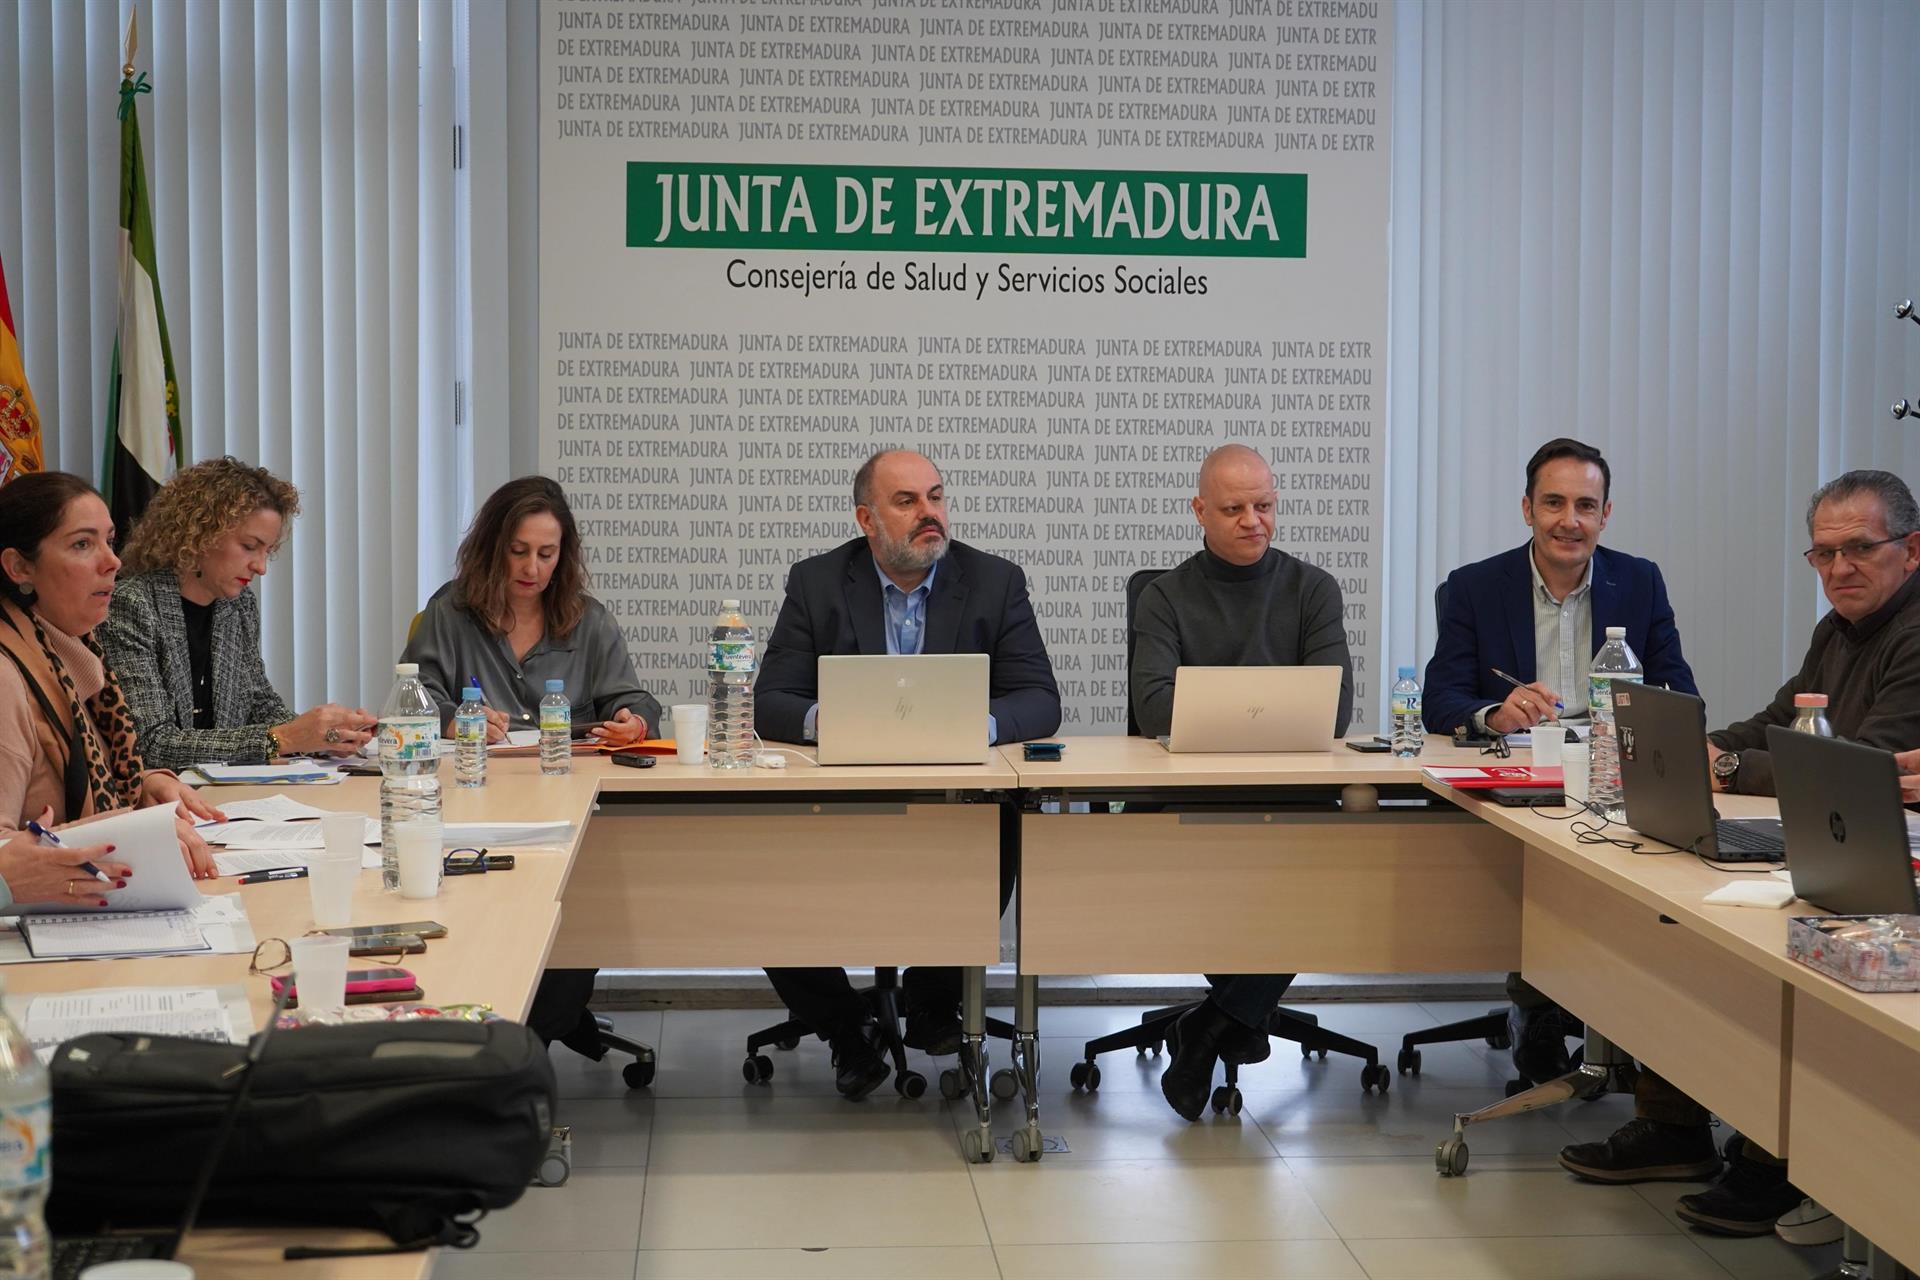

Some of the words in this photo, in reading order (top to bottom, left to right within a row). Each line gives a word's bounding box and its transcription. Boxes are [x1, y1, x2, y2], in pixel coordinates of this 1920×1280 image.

[558, 12, 602, 31] JUNTA
[607, 12, 623, 29] DE
[628, 13, 730, 31] EXTREMADURA
[740, 14, 783, 34] JUNTA
[788, 16, 805, 32] DE
[810, 16, 910, 34] EXTREMADURA
[920, 18, 963, 38] JUNTA
[968, 19, 984, 36] DE
[989, 20, 1089, 38] EXTREMADURA
[1099, 22, 1142, 42] JUNTA
[1146, 23, 1163, 40] DE
[1167, 24, 1266, 42] EXTREMADURA
[1276, 26, 1319, 46] JUNTA
[1323, 28, 1340, 44] DE
[557, 39, 574, 56] DE
[579, 39, 680, 57] EXTREMADURA
[691, 41, 735, 61] JUNTA
[739, 41, 756, 58] DE
[761, 42, 861, 60] EXTREMADURA
[872, 44, 915, 64] JUNTA
[919, 45, 936, 62] DE
[940, 46, 1040, 64] EXTREMADURA
[1051, 48, 1094, 67] JUNTA
[1098, 49, 1114, 66] DE
[1119, 49, 1218, 68] EXTREMADURA
[1228, 52, 1271, 72] JUNTA
[1275, 54, 1292, 70] DE
[558, 66, 602, 85] JUNTA
[606, 66, 623, 83] DE
[628, 67, 729, 85] EXTREMADURA
[740, 68, 783, 88] JUNTA
[787, 69, 804, 86] DE
[809, 70, 910, 88] EXTREMADURA
[919, 72, 963, 92] JUNTA
[967, 73, 984, 90] DE
[988, 73, 1088, 92] EXTREMADURA
[1098, 76, 1141, 95] JUNTA
[1145, 77, 1162, 93] DE
[1167, 77, 1265, 95] EXTREMADURA
[1275, 80, 1318, 99] JUNTA
[1322, 81, 1339, 97] DE
[557, 93, 574, 110] DE
[579, 93, 680, 111] EXTREMADURA
[691, 95, 734, 114] JUNTA
[738, 95, 755, 112] DE
[760, 96, 861, 114] EXTREMADURA
[871, 98, 914, 118] JUNTA
[918, 99, 935, 116] DE
[940, 100, 1040, 118] EXTREMADURA
[1050, 101, 1093, 121] JUNTA
[1097, 102, 1113, 119] DE
[1118, 103, 1217, 121] EXTREMADURA
[1227, 105, 1270, 125] JUNTA
[1274, 107, 1291, 123] DE
[558, 120, 601, 139] JUNTA
[606, 120, 623, 137] DE
[628, 121, 729, 139] EXTREMADURA
[739, 122, 782, 141] JUNTA
[787, 123, 804, 140] DE
[808, 124, 909, 142] EXTREMADURA
[919, 126, 962, 146] JUNTA
[966, 127, 983, 143] DE
[988, 127, 1087, 146] EXTREMADURA
[1097, 129, 1140, 148] JUNTA
[1144, 130, 1161, 147] DE
[1166, 130, 1264, 148] EXTREMADURA
[1275, 133, 1317, 152] JUNTA
[1321, 134, 1337, 150] DE
[654, 174, 816, 243] JUNTA
[835, 177, 896, 236] DE
[914, 178, 1280, 242] EXTREMADURA
[726, 258, 857, 298] Consejería
[866, 260, 896, 291] de
[904, 260, 968, 293] Salud
[976, 270, 989, 300] y
[997, 262, 1106, 294] Servicios
[1114, 264, 1209, 296] Sociales
[558, 332, 602, 351] JUNTA
[606, 333, 623, 349] DE
[628, 333, 728, 350] EXTREMADURA
[739, 334, 782, 354] JUNTA
[787, 335, 803, 351] DE
[808, 336, 908, 353] EXTREMADURA
[918, 337, 961, 356] JUNTA
[965, 337, 982, 354] DE
[986, 338, 1086, 355] EXTREMADURA
[1096, 339, 1138, 359] JUNTA
[1143, 340, 1159, 356] DE
[1164, 340, 1262, 357] EXTREMADURA
[1272, 341, 1314, 360] JUNTA
[1318, 342, 1335, 358] DE
[557, 360, 574, 376] DE
[579, 360, 679, 377] EXTREMADURA
[690, 361, 733, 381] JUNTA
[737, 362, 754, 378] DE
[759, 362, 859, 379] EXTREMADURA
[870, 363, 913, 383] JUNTA
[917, 363, 933, 380] DE
[938, 364, 1037, 381] EXTREMADURA
[1048, 365, 1090, 384] JUNTA
[1095, 366, 1111, 382] DE
[1116, 366, 1214, 383] EXTREMADURA
[1224, 368, 1267, 387] JUNTA
[1271, 368, 1287, 384] DE
[558, 386, 602, 406] JUNTA
[606, 387, 623, 403] DE
[627, 387, 728, 404] EXTREMADURA
[738, 388, 782, 408] JUNTA
[786, 389, 803, 405] DE
[808, 389, 908, 406] EXTREMADURA
[917, 390, 960, 409] JUNTA
[965, 390, 981, 407] DE
[986, 390, 1085, 408] EXTREMADURA
[1095, 392, 1138, 412] JUNTA
[1142, 392, 1158, 409] DE
[1163, 393, 1261, 410] EXTREMADURA
[1271, 394, 1314, 413] JUNTA
[1318, 394, 1334, 410] DE
[557, 413, 574, 430] DE
[579, 413, 680, 431] EXTREMADURA
[689, 414, 733, 433] JUNTA
[738, 415, 754, 432] DE
[759, 416, 859, 432] EXTREMADURA
[869, 416, 912, 435] JUNTA
[916, 416, 933, 433] DE
[938, 417, 1037, 434] EXTREMADURA
[1047, 418, 1090, 437] JUNTA
[1094, 418, 1110, 435] DE
[1115, 419, 1214, 436] EXTREMADURA
[1224, 420, 1266, 439] JUNTA
[1270, 421, 1287, 437] DE
[558, 440, 601, 459] JUNTA
[606, 440, 623, 457] DE
[628, 440, 728, 457] EXTREMADURA
